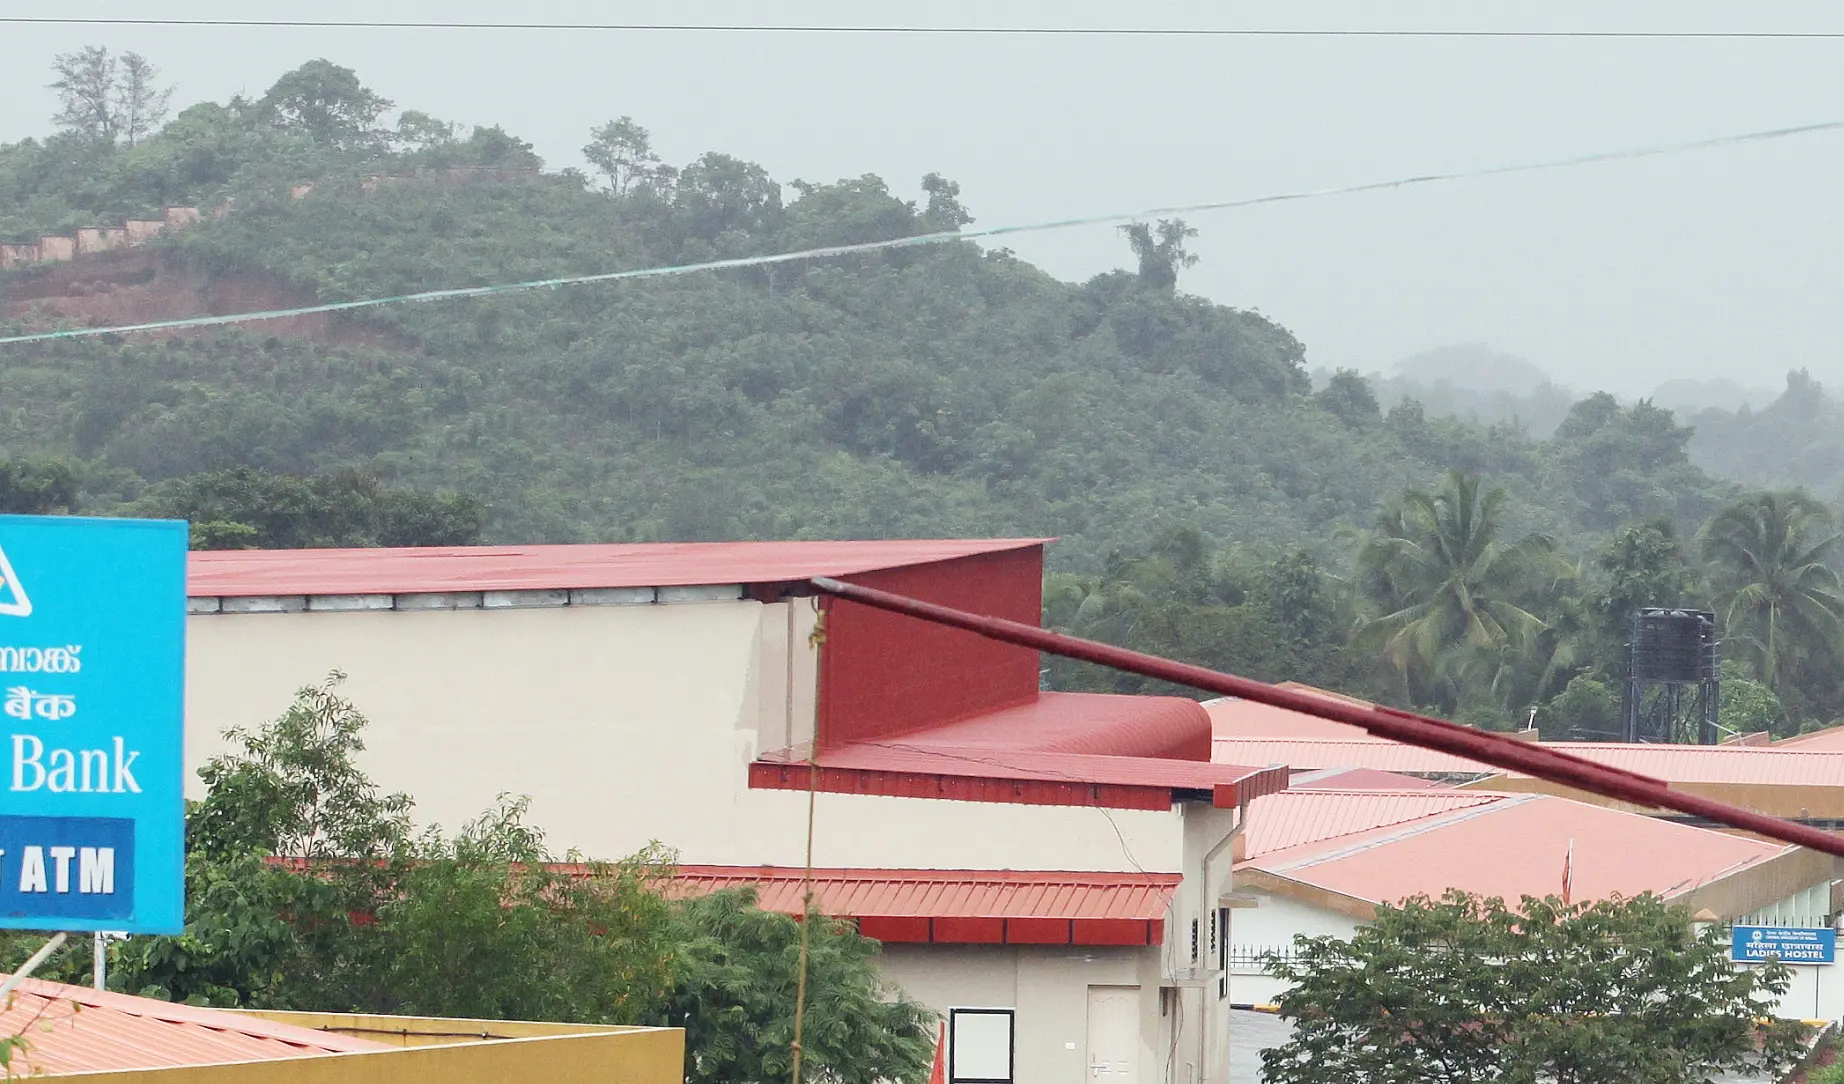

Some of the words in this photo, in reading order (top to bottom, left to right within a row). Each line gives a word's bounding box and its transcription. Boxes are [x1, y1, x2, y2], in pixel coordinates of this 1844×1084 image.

[4, 685, 76, 720] बैंक
[9, 734, 143, 794] Bank
[19, 845, 115, 894] ATM
[1784, 950, 1824, 959] HOSTEL
